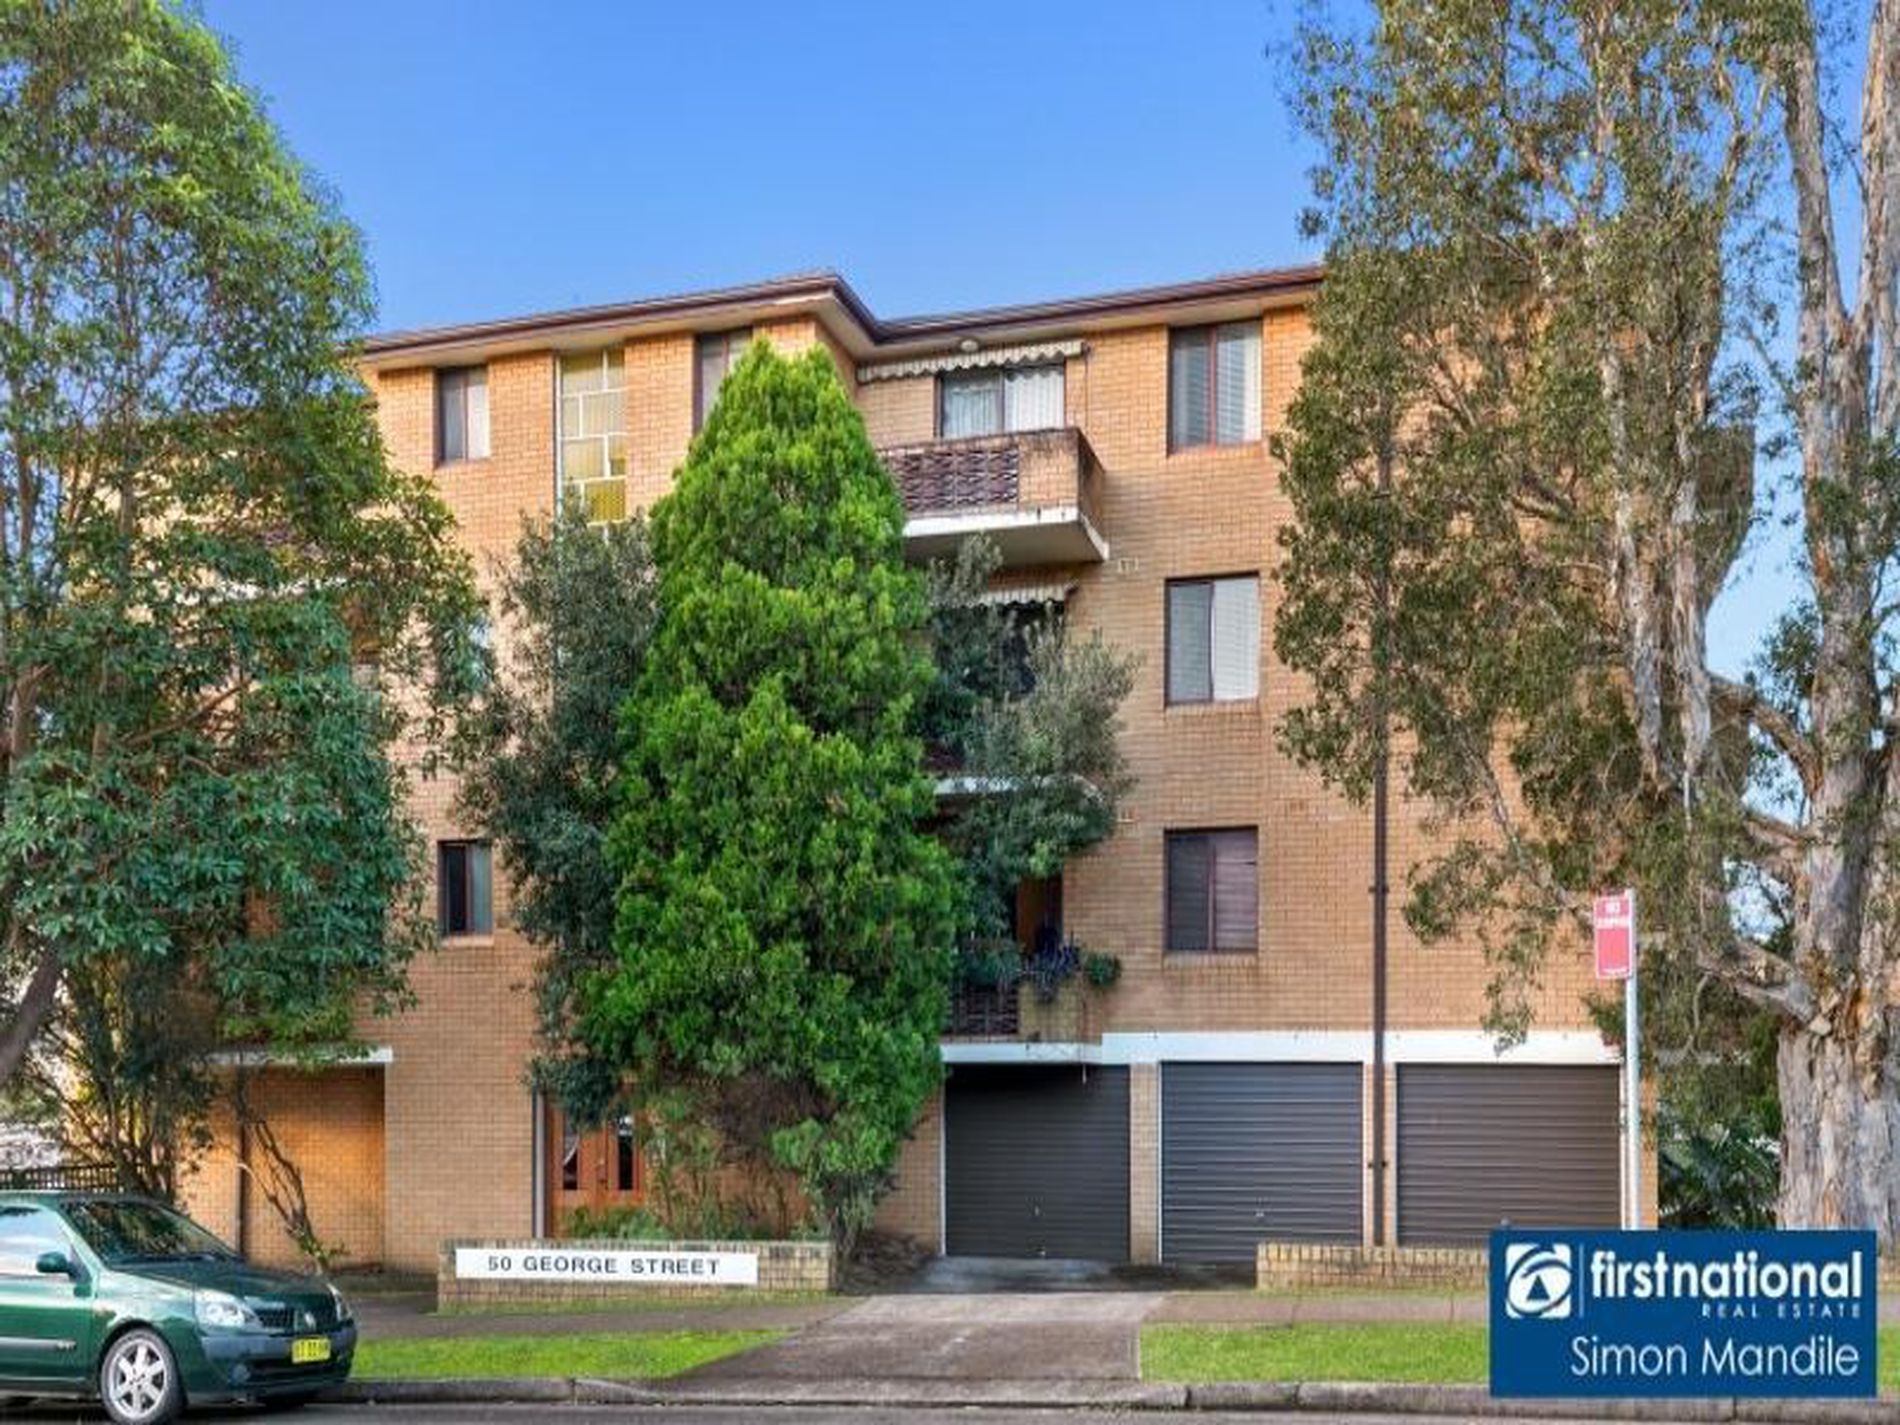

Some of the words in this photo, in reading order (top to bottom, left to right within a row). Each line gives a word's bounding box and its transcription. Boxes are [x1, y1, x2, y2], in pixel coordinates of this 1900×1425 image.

[488, 1256, 512, 1271] 50
[523, 1256, 618, 1274] GEORGE
[631, 1258, 720, 1275] STREET
